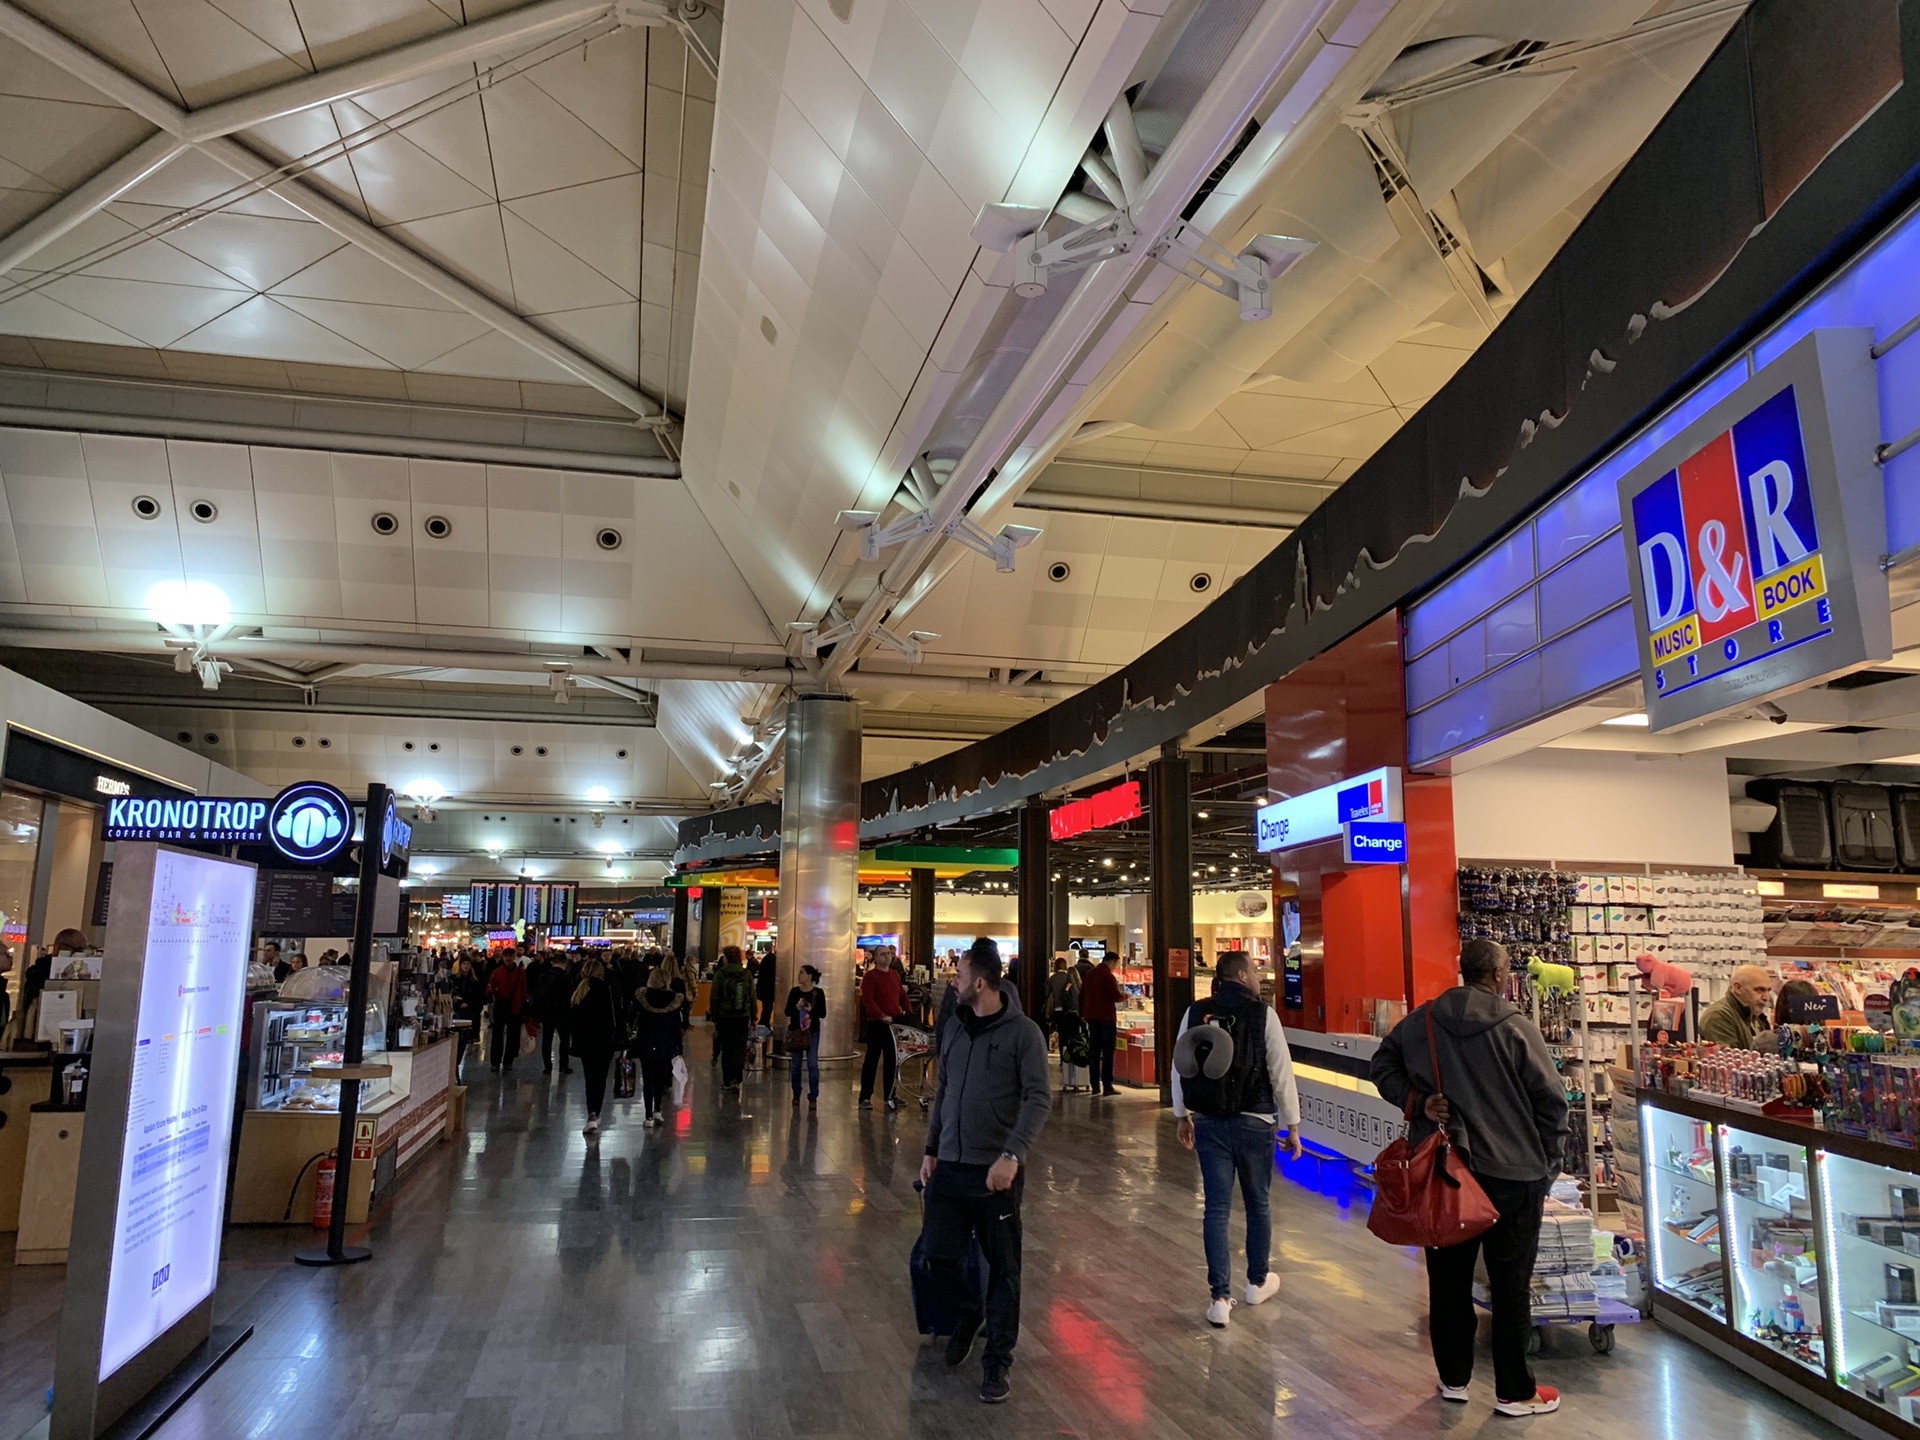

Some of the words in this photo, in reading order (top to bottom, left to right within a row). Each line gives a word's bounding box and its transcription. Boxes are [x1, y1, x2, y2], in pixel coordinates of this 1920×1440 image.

[1639, 460, 1809, 632] D&R
[1762, 566, 1816, 611] BOOK
[1653, 623, 1695, 661] MUSIC
[1655, 597, 1833, 691] STORE
[108, 798, 267, 830] KRONOTROP
[1260, 818, 1290, 842] Change
[107, 829, 152, 839] COFFEE
[159, 830, 182, 839] BAR
[189, 831, 197, 839] &
[203, 831, 263, 841] ROASTERY
[1353, 835, 1403, 852] Change
